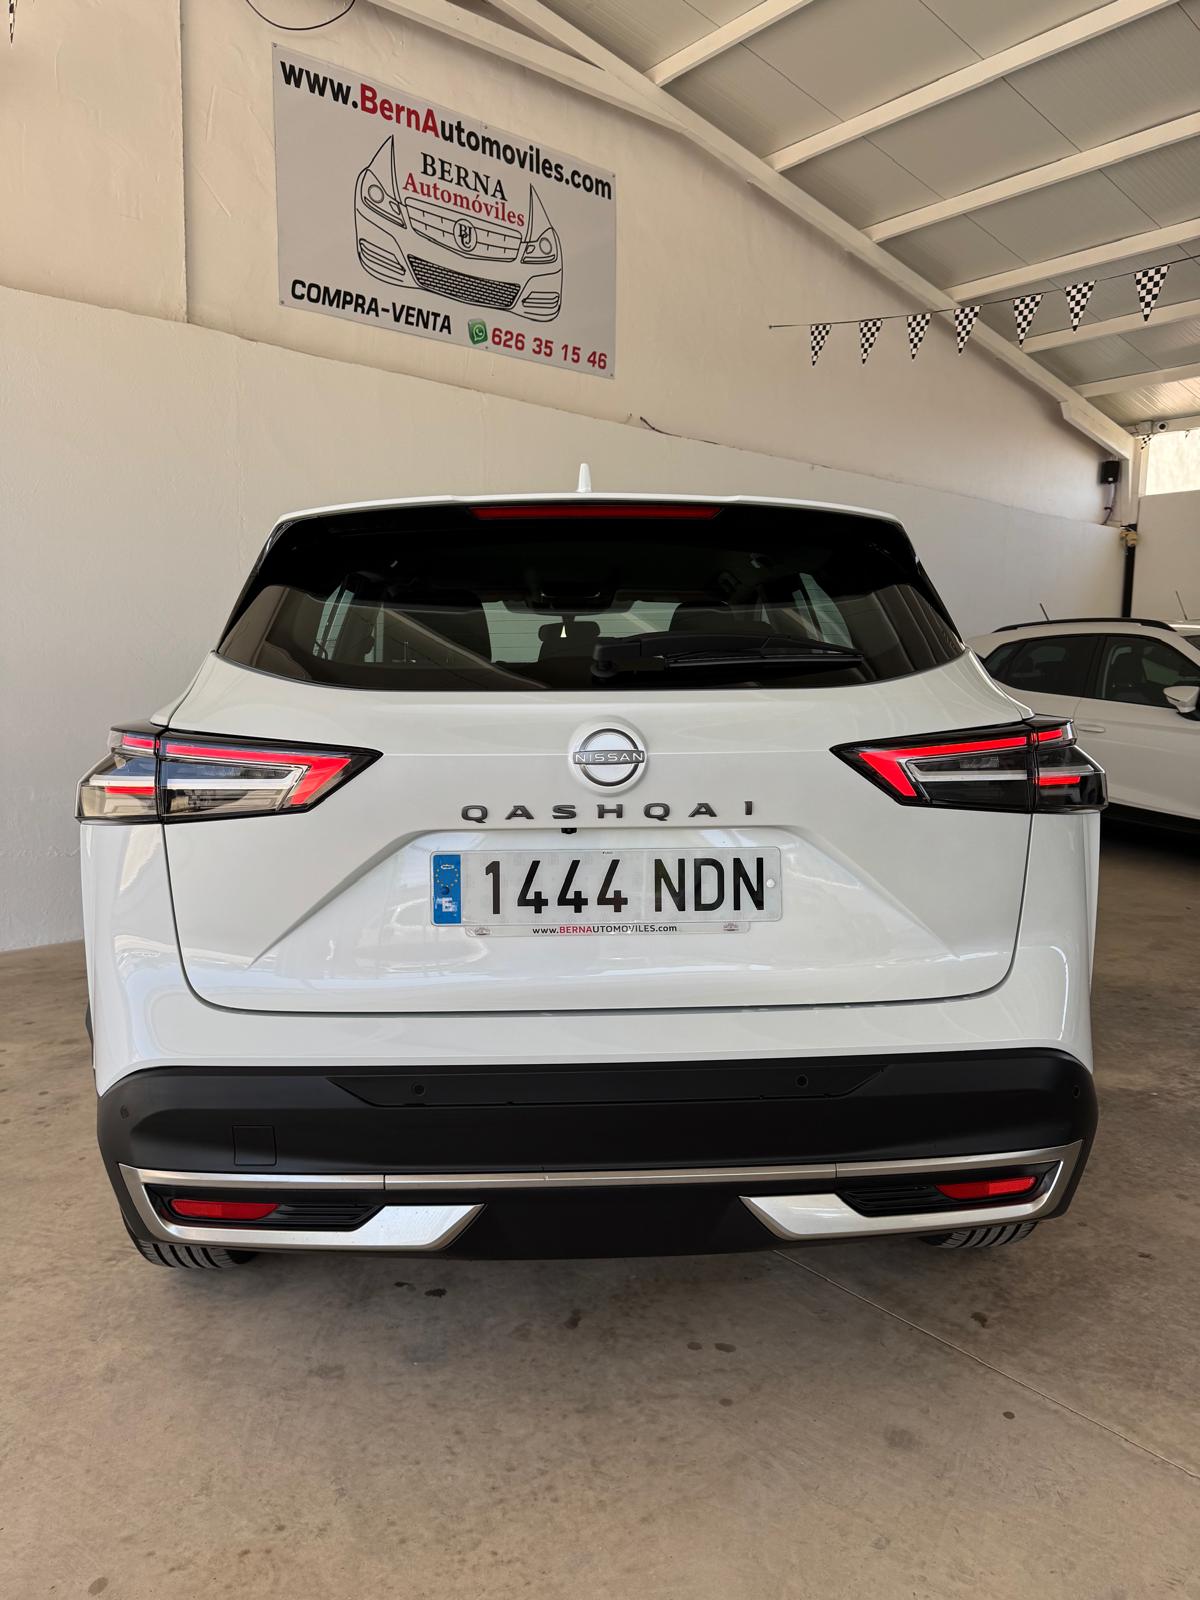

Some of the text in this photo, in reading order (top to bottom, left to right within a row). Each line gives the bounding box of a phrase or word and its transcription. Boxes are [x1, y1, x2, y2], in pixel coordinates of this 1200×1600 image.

[280, 61, 612, 200] www.BernAutomoviles.com
[402, 172, 525, 227] Automóviles
[420, 152, 508, 202] BERNA
[290, 279, 452, 335] COMPRA-VENTA
[491, 327, 607, 370] 626 35 15 46
[575, 752, 643, 762] NISSAN
[461, 801, 753, 823] QASHQAI
[485, 857, 764, 914] 1444 NDN
[532, 924, 678, 934] www.BERNAUTOMOVILES.com
